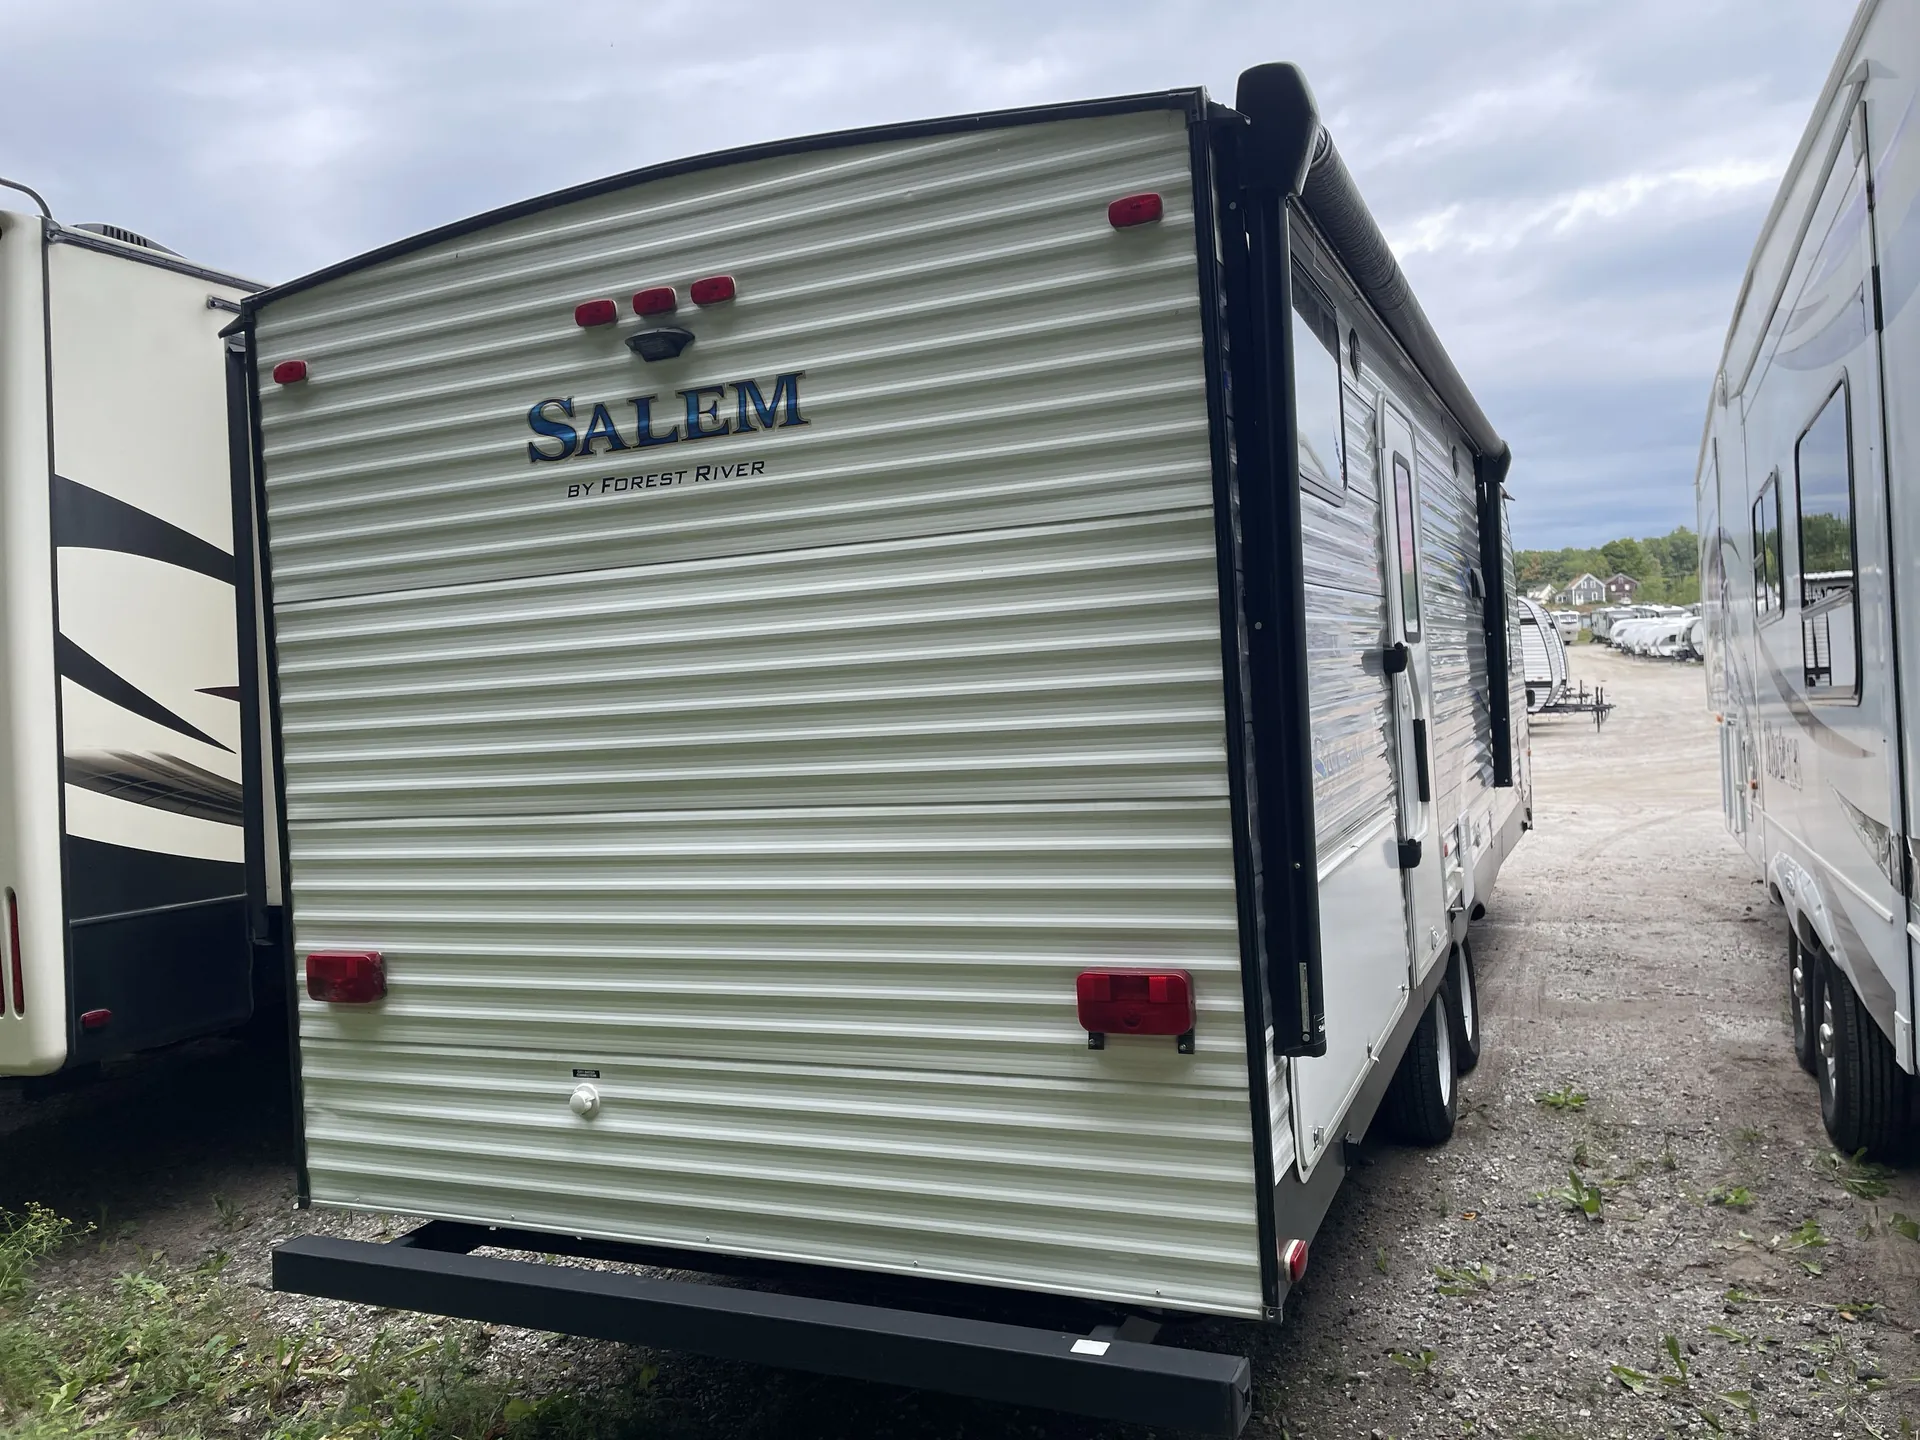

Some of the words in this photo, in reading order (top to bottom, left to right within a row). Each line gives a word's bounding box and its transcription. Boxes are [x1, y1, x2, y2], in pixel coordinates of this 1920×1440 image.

[526, 370, 812, 463] SALEM
[567, 482, 594, 498] BY
[601, 470, 687, 494] FOREST
[694, 461, 765, 483] RIVER
